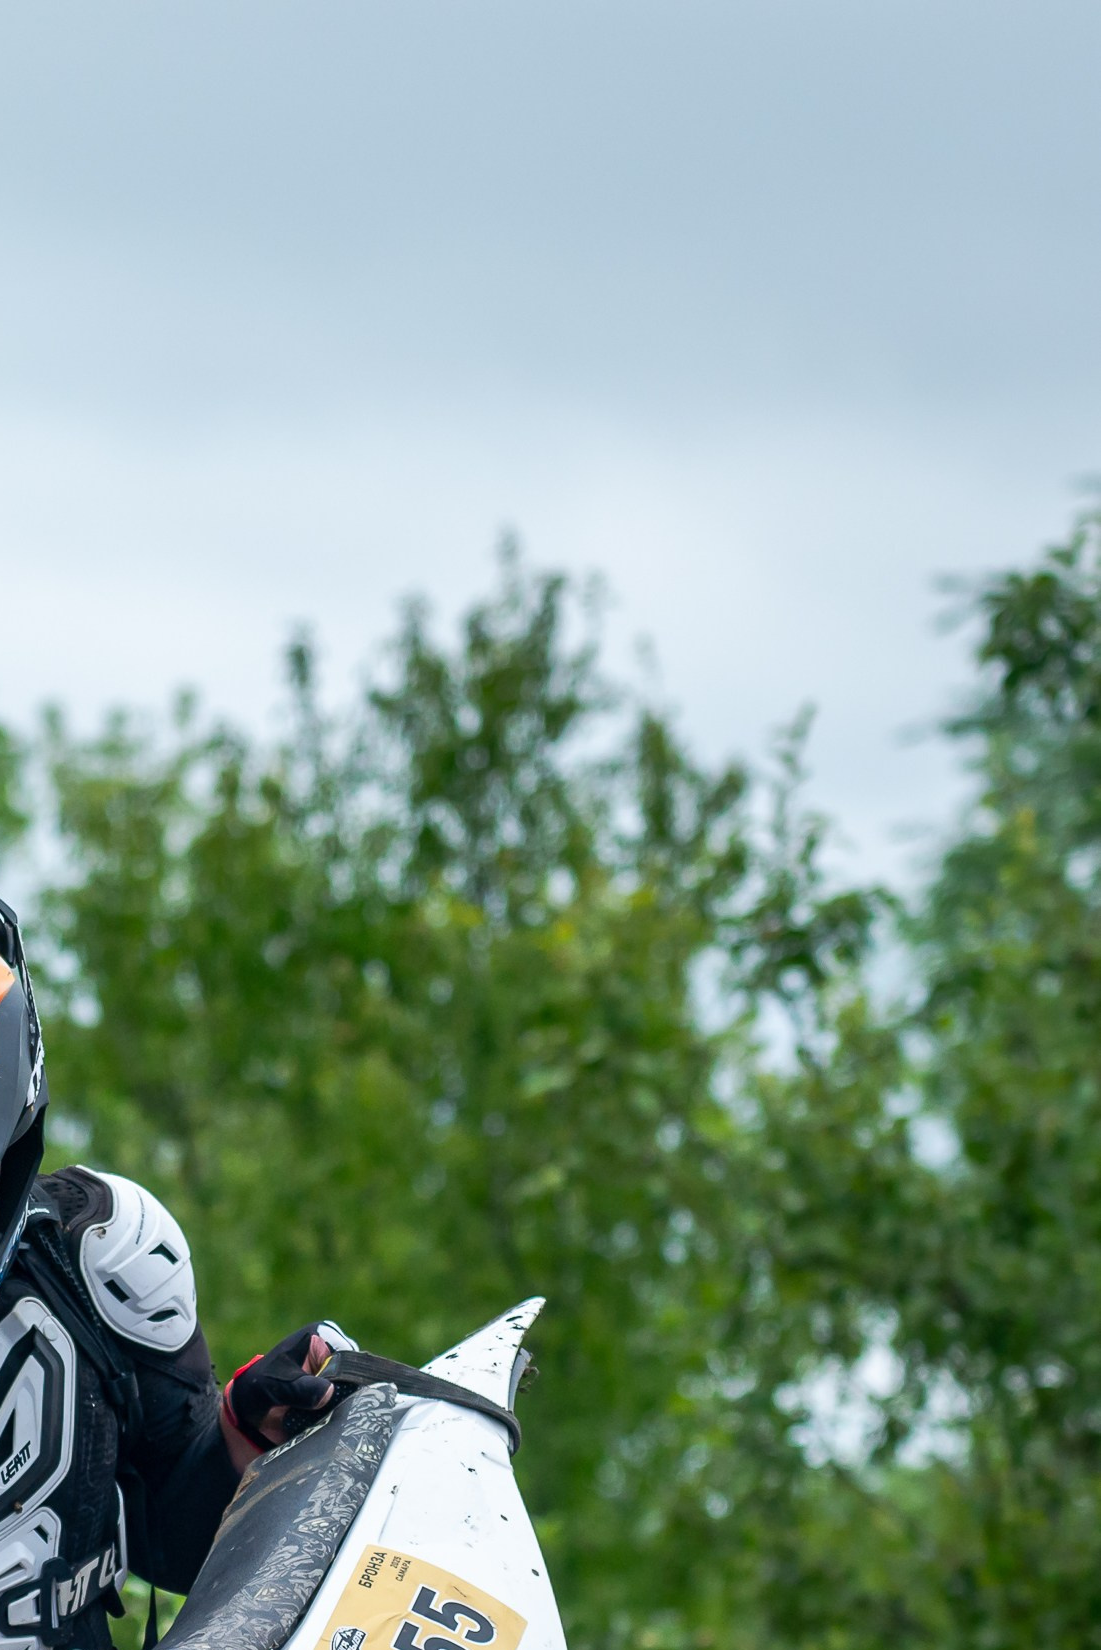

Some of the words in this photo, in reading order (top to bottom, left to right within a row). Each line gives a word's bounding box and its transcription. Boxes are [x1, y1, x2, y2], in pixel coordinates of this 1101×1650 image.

[0, 1440, 31, 1485] LEATT
[358, 1551, 387, 1589] БРОНЗА
[389, 1556, 402, 1568] 2025
[395, 1560, 412, 1582] САМАРА
